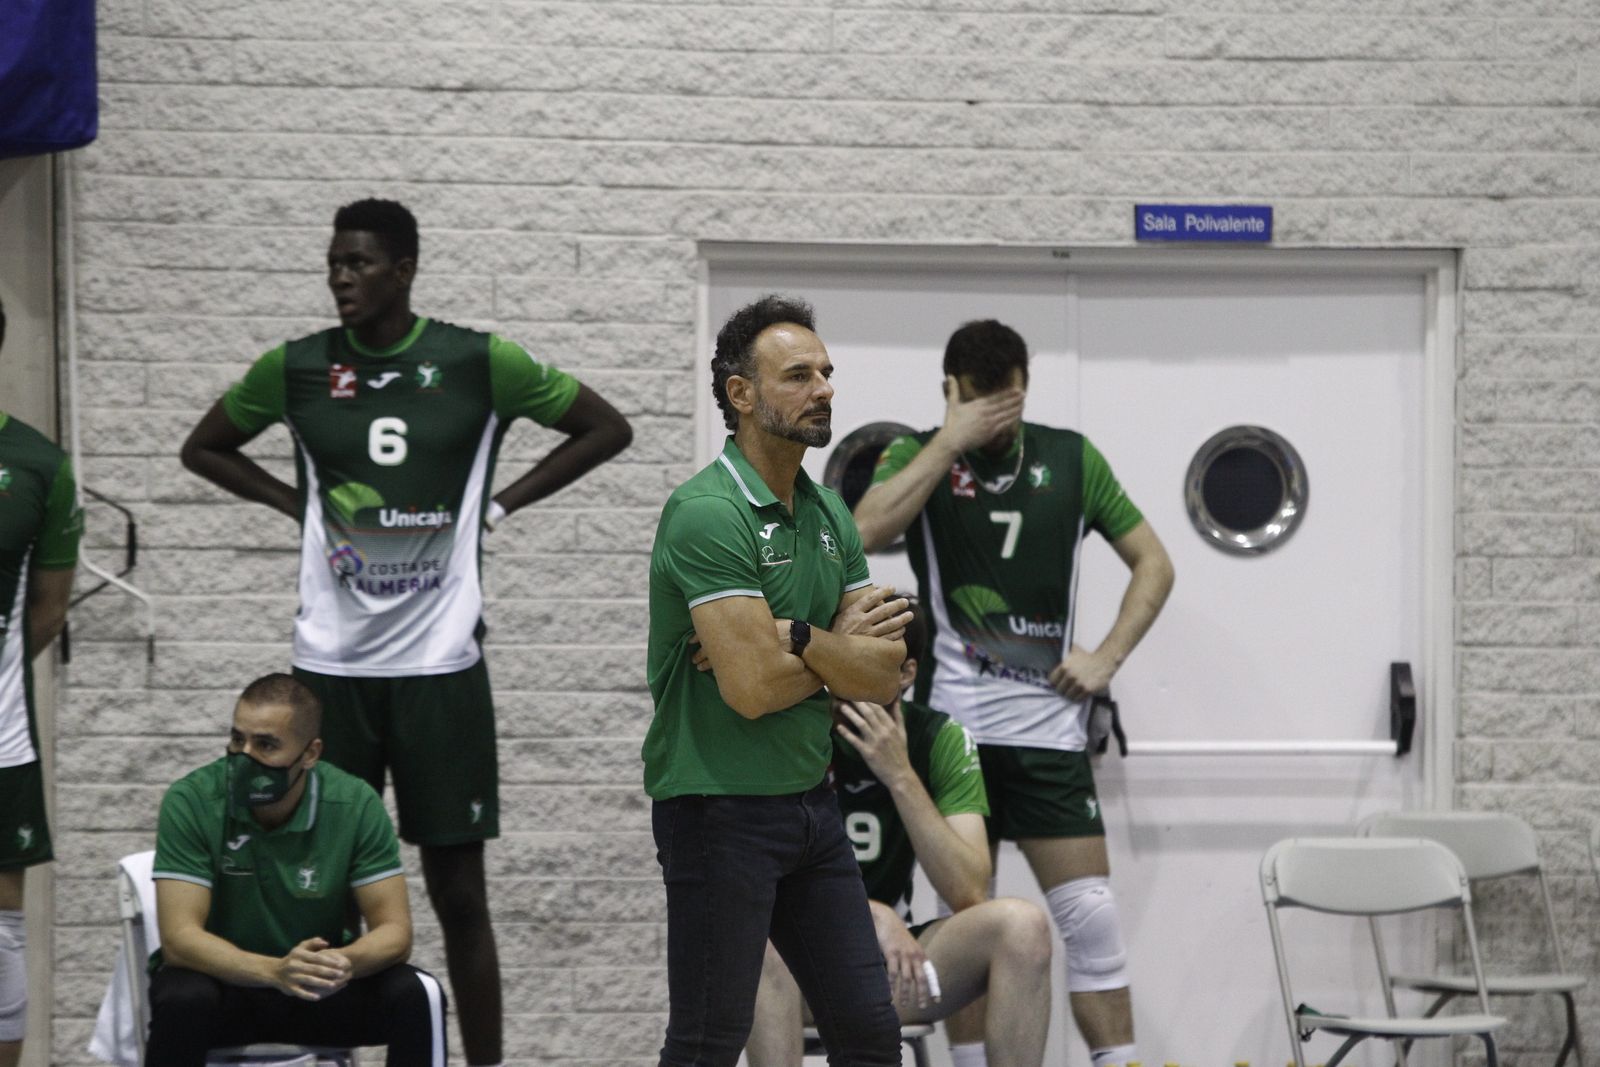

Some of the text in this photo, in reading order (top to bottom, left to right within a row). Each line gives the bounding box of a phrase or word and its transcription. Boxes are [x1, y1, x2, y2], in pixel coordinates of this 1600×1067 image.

[1143, 212, 1266, 233] Sala Polivalente
[368, 416, 408, 467] 6
[989, 511, 1023, 559] 7
[845, 811, 882, 862] 9
